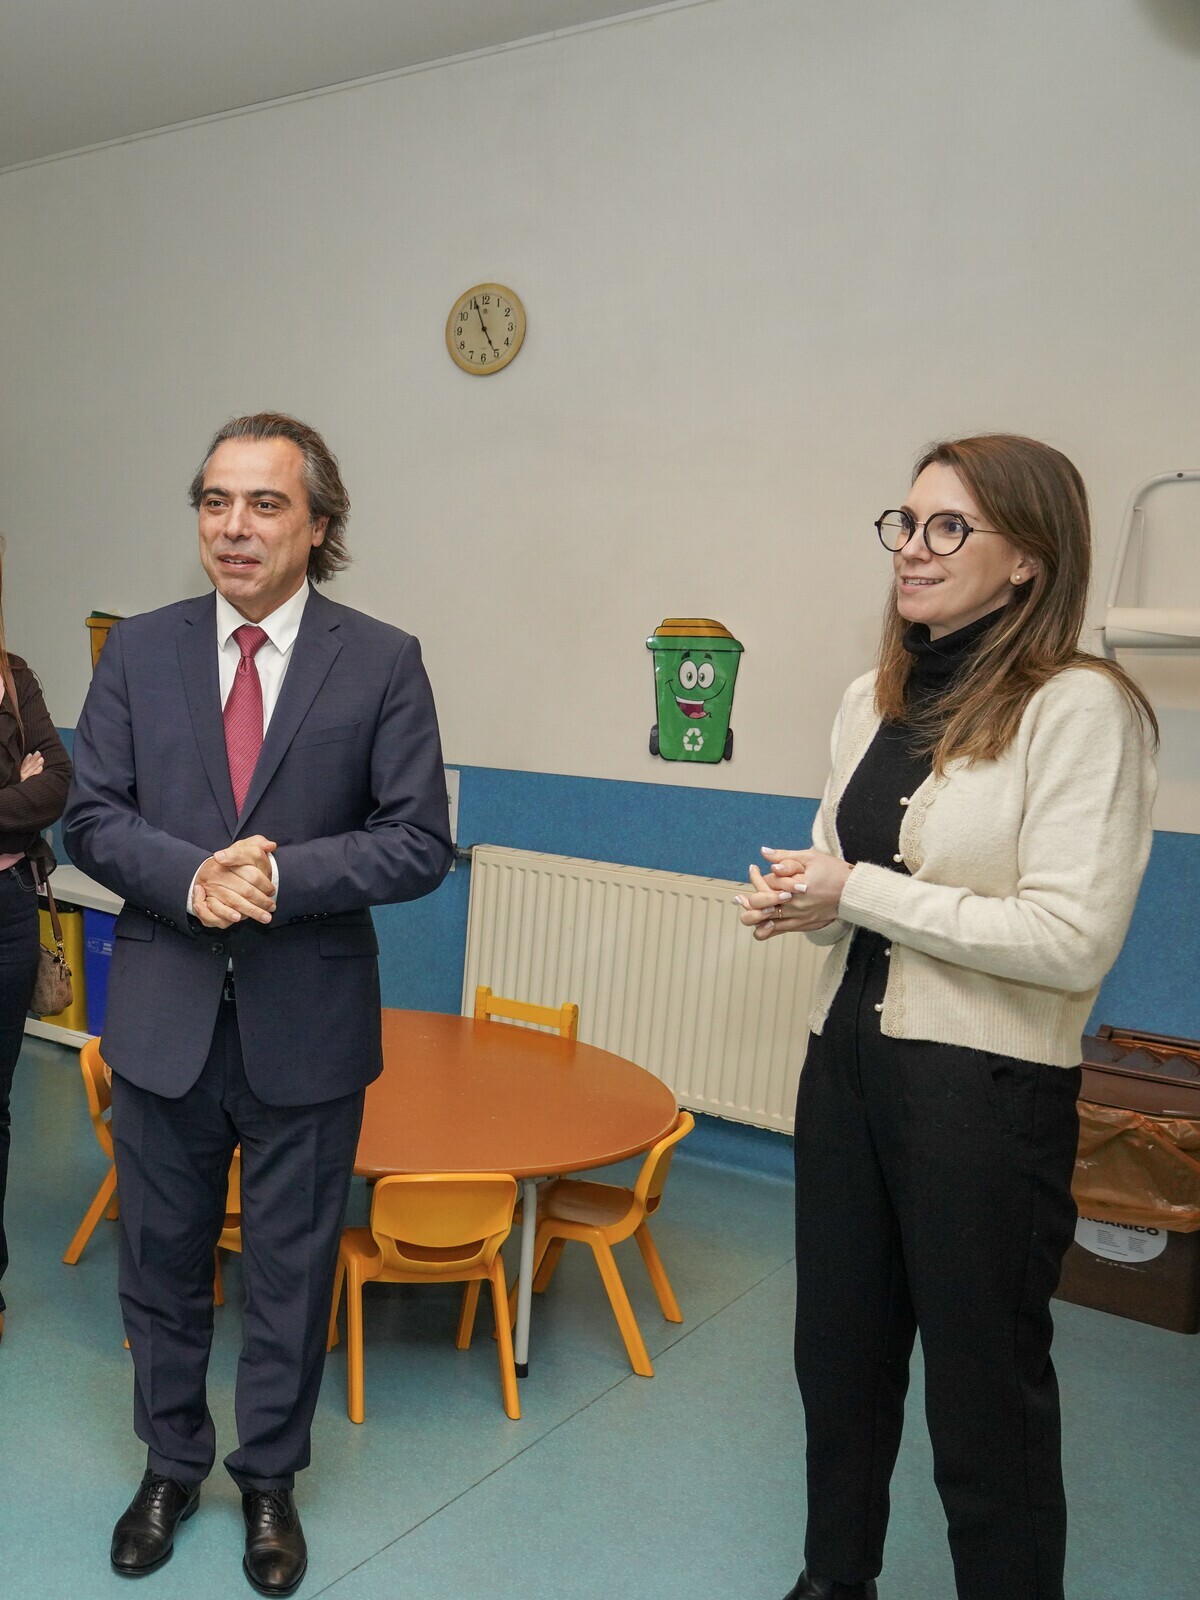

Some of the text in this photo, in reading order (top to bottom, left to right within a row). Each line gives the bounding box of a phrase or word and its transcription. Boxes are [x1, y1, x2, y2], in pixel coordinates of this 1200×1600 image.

[482, 296, 490, 305] 12
[497, 298, 500, 307] 1
[460, 312, 468, 321] 10
[504, 308, 511, 317] 2
[457, 327, 462, 336] 9
[508, 322, 514, 332] 3
[460, 341, 465, 350] 8
[504, 337, 509, 346] 4
[469, 350, 474, 360] 7
[481, 353, 486, 362] 6
[494, 348, 500, 358] 5
